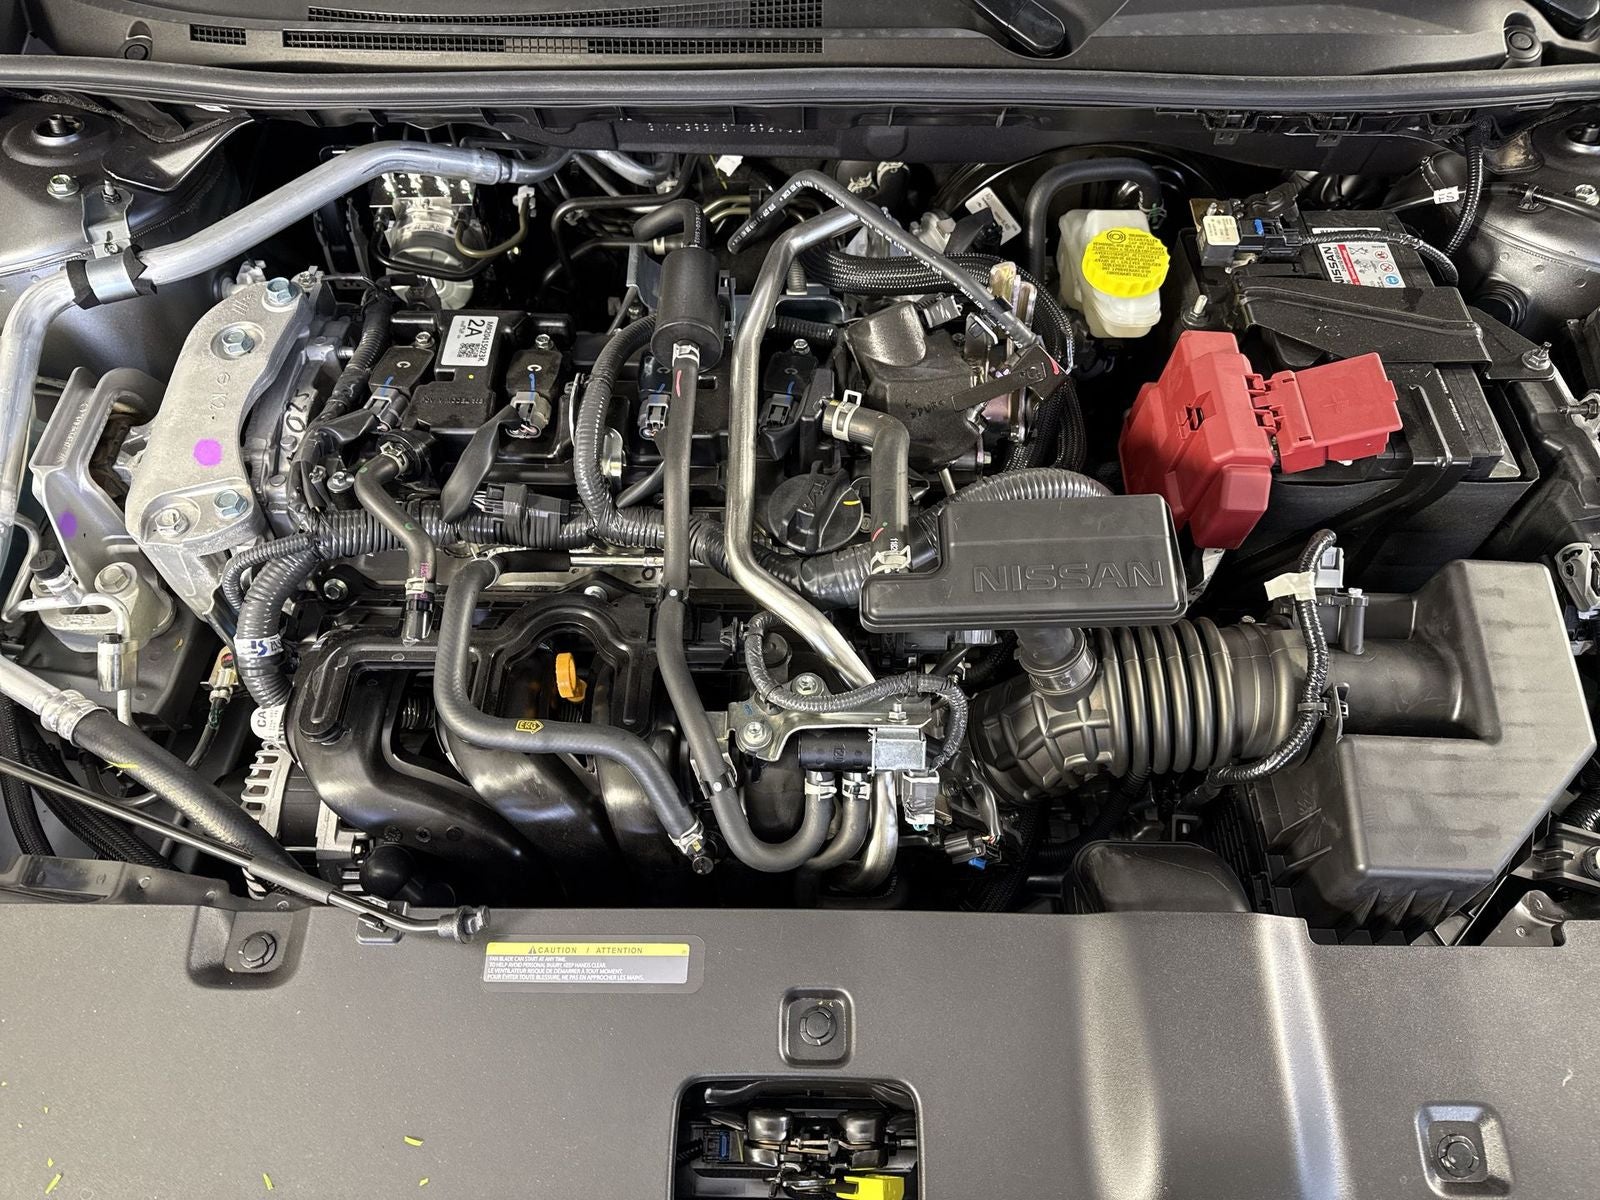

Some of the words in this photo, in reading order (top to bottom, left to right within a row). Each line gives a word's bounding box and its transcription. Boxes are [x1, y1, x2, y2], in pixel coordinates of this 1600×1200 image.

[464, 319, 486, 337] 2A
[973, 560, 1164, 592] NISSAN
[537, 946, 577, 954] CAUTION
[595, 946, 643, 954] ATTENTION
[487, 973, 501, 981] POUR
[586, 973, 616, 981] APPROCHER
